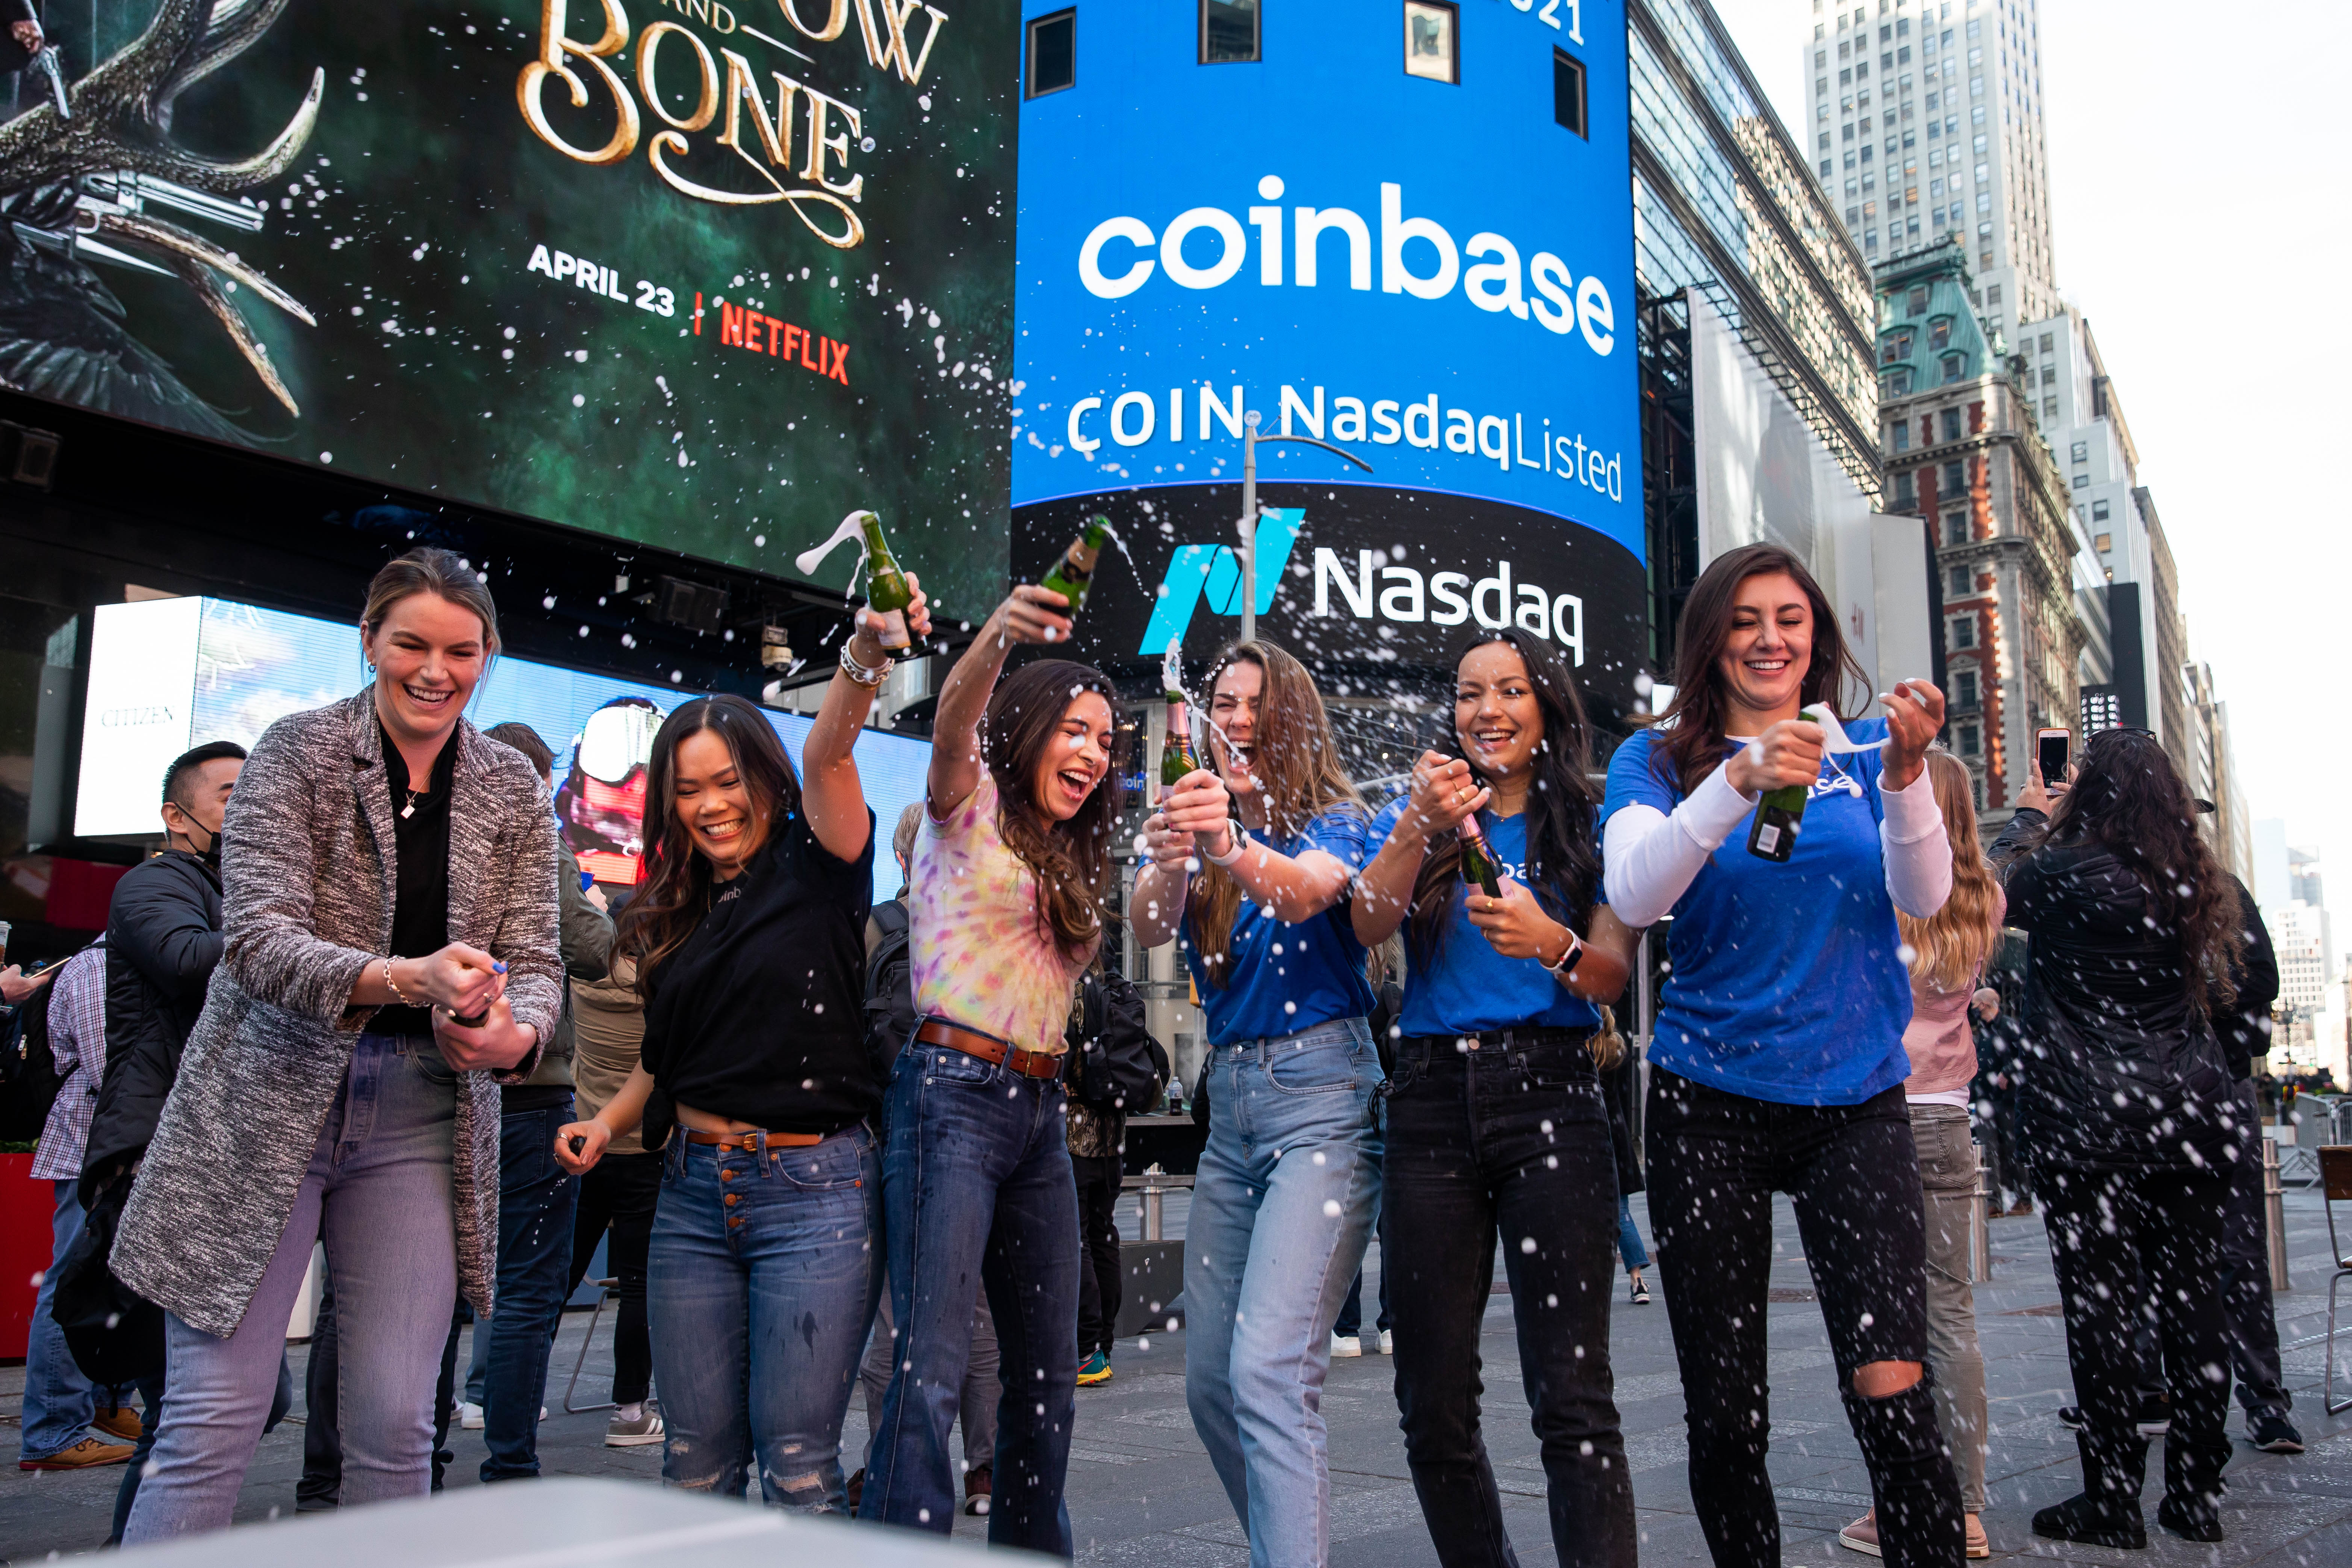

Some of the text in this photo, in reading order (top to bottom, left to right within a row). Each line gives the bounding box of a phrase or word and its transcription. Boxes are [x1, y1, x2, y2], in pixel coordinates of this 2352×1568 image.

[1510, 0, 1584, 46] 21
[516, 0, 865, 249] BONE
[527, 244, 675, 318] APRIL 23
[1078, 175, 1614, 357] coinbase
[721, 301, 850, 386] NETFLIX
[1068, 385, 1243, 452] COIN
[1316, 547, 1584, 668] Nasdaq
[101, 706, 174, 727] CITIZEN
